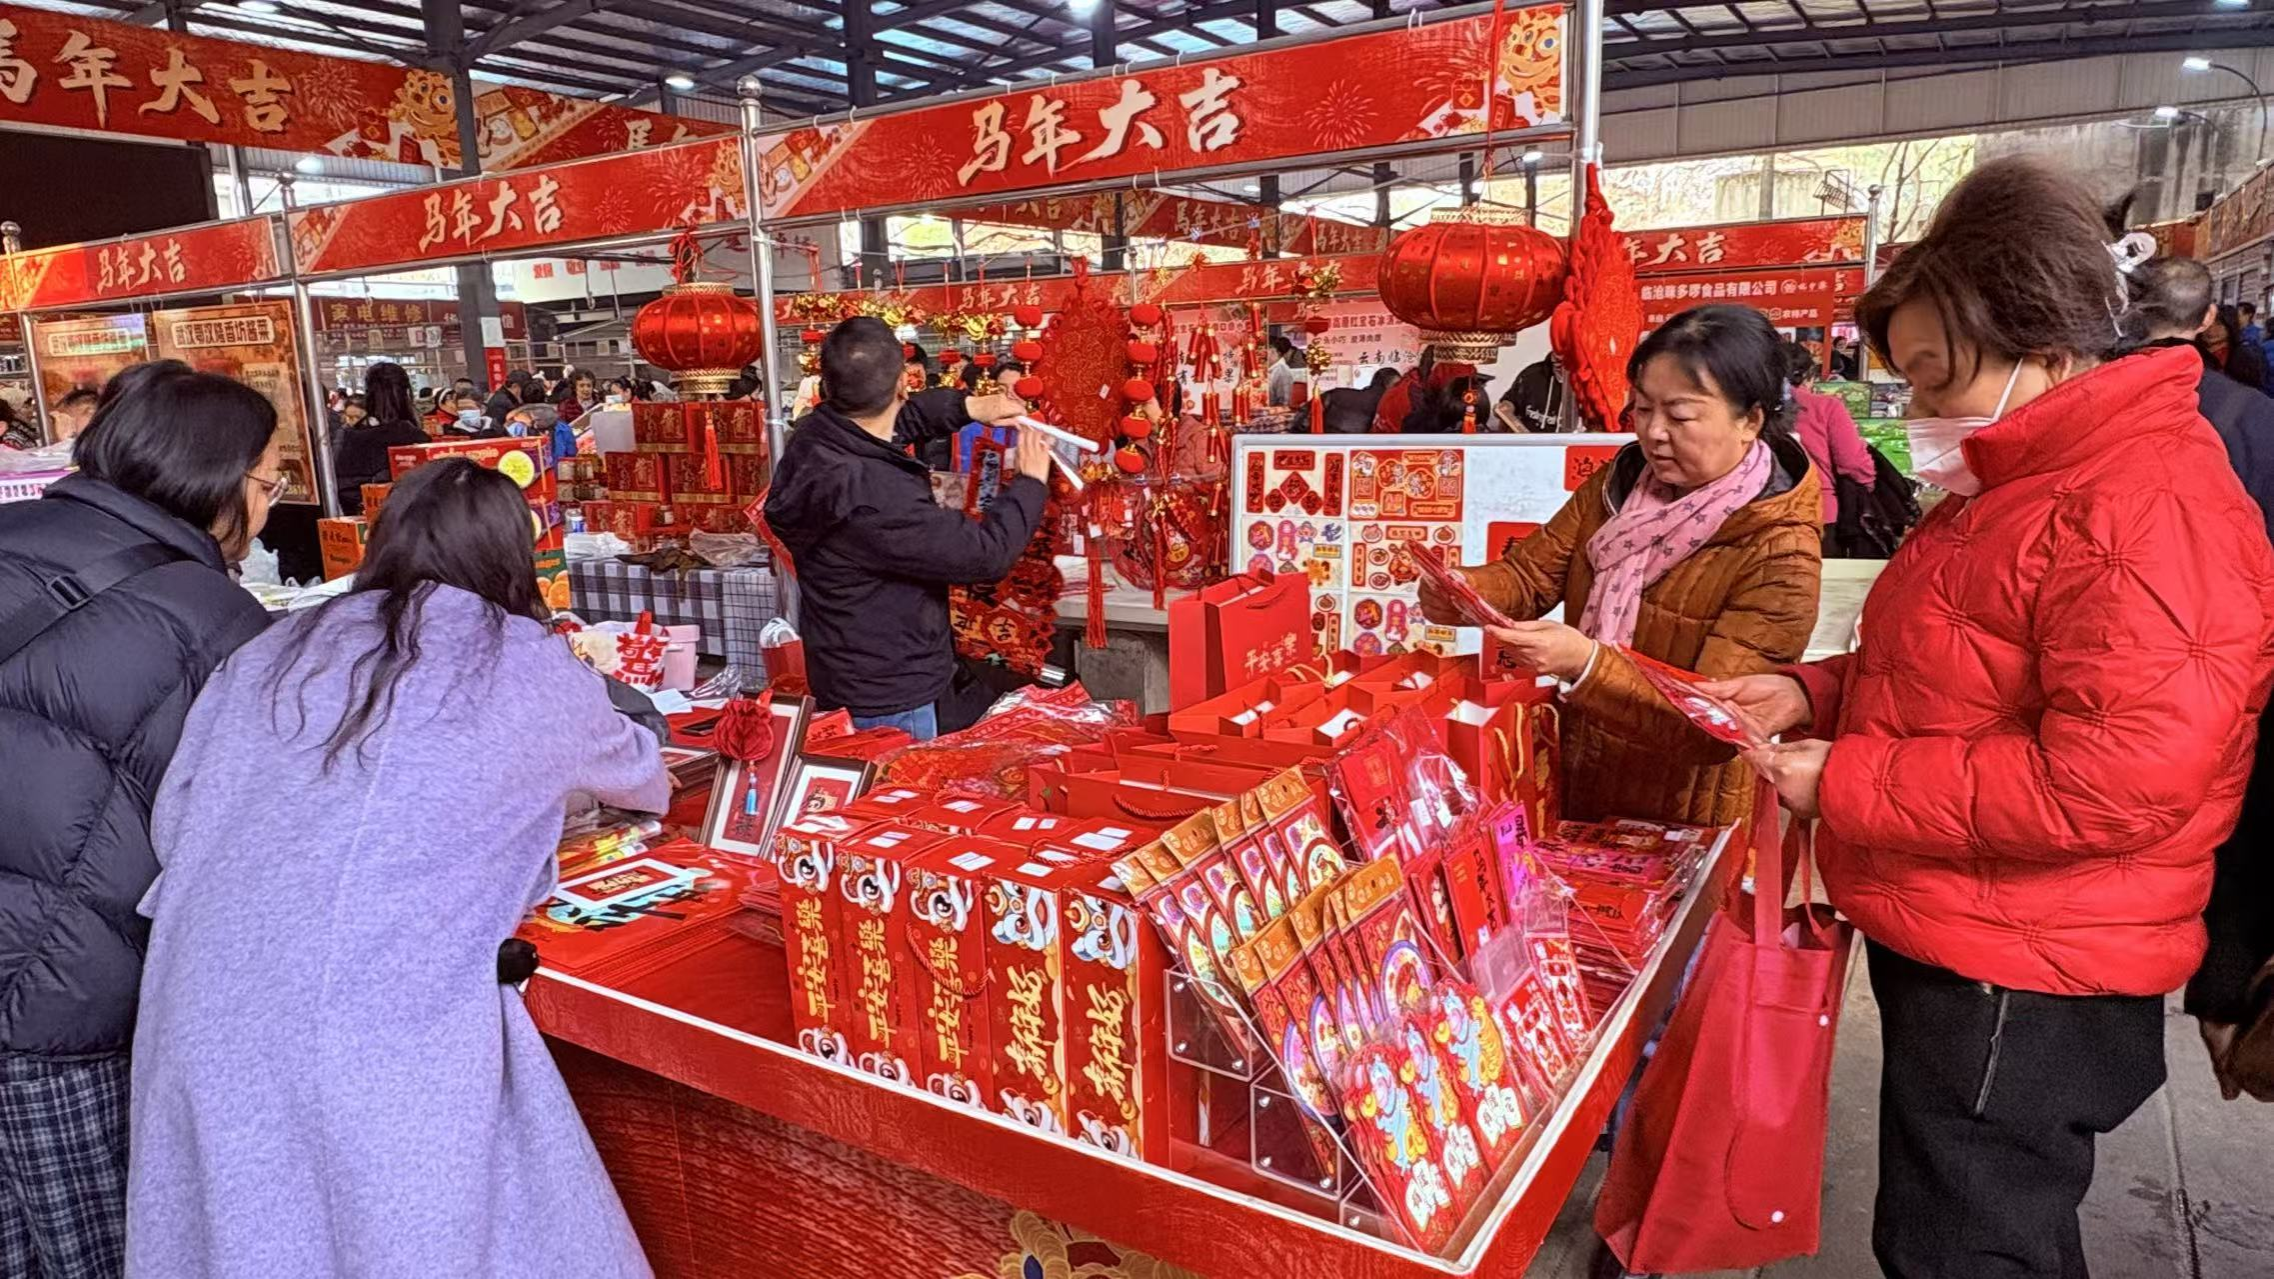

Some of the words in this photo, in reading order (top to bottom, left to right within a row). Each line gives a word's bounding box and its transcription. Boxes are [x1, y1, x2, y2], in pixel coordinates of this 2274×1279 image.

[957, 68, 1245, 187] 马年大吉
[418, 174, 565, 254] 马年大吉
[97, 238, 188, 294] 马年大吉
[330, 303, 423, 323] 家电维修
